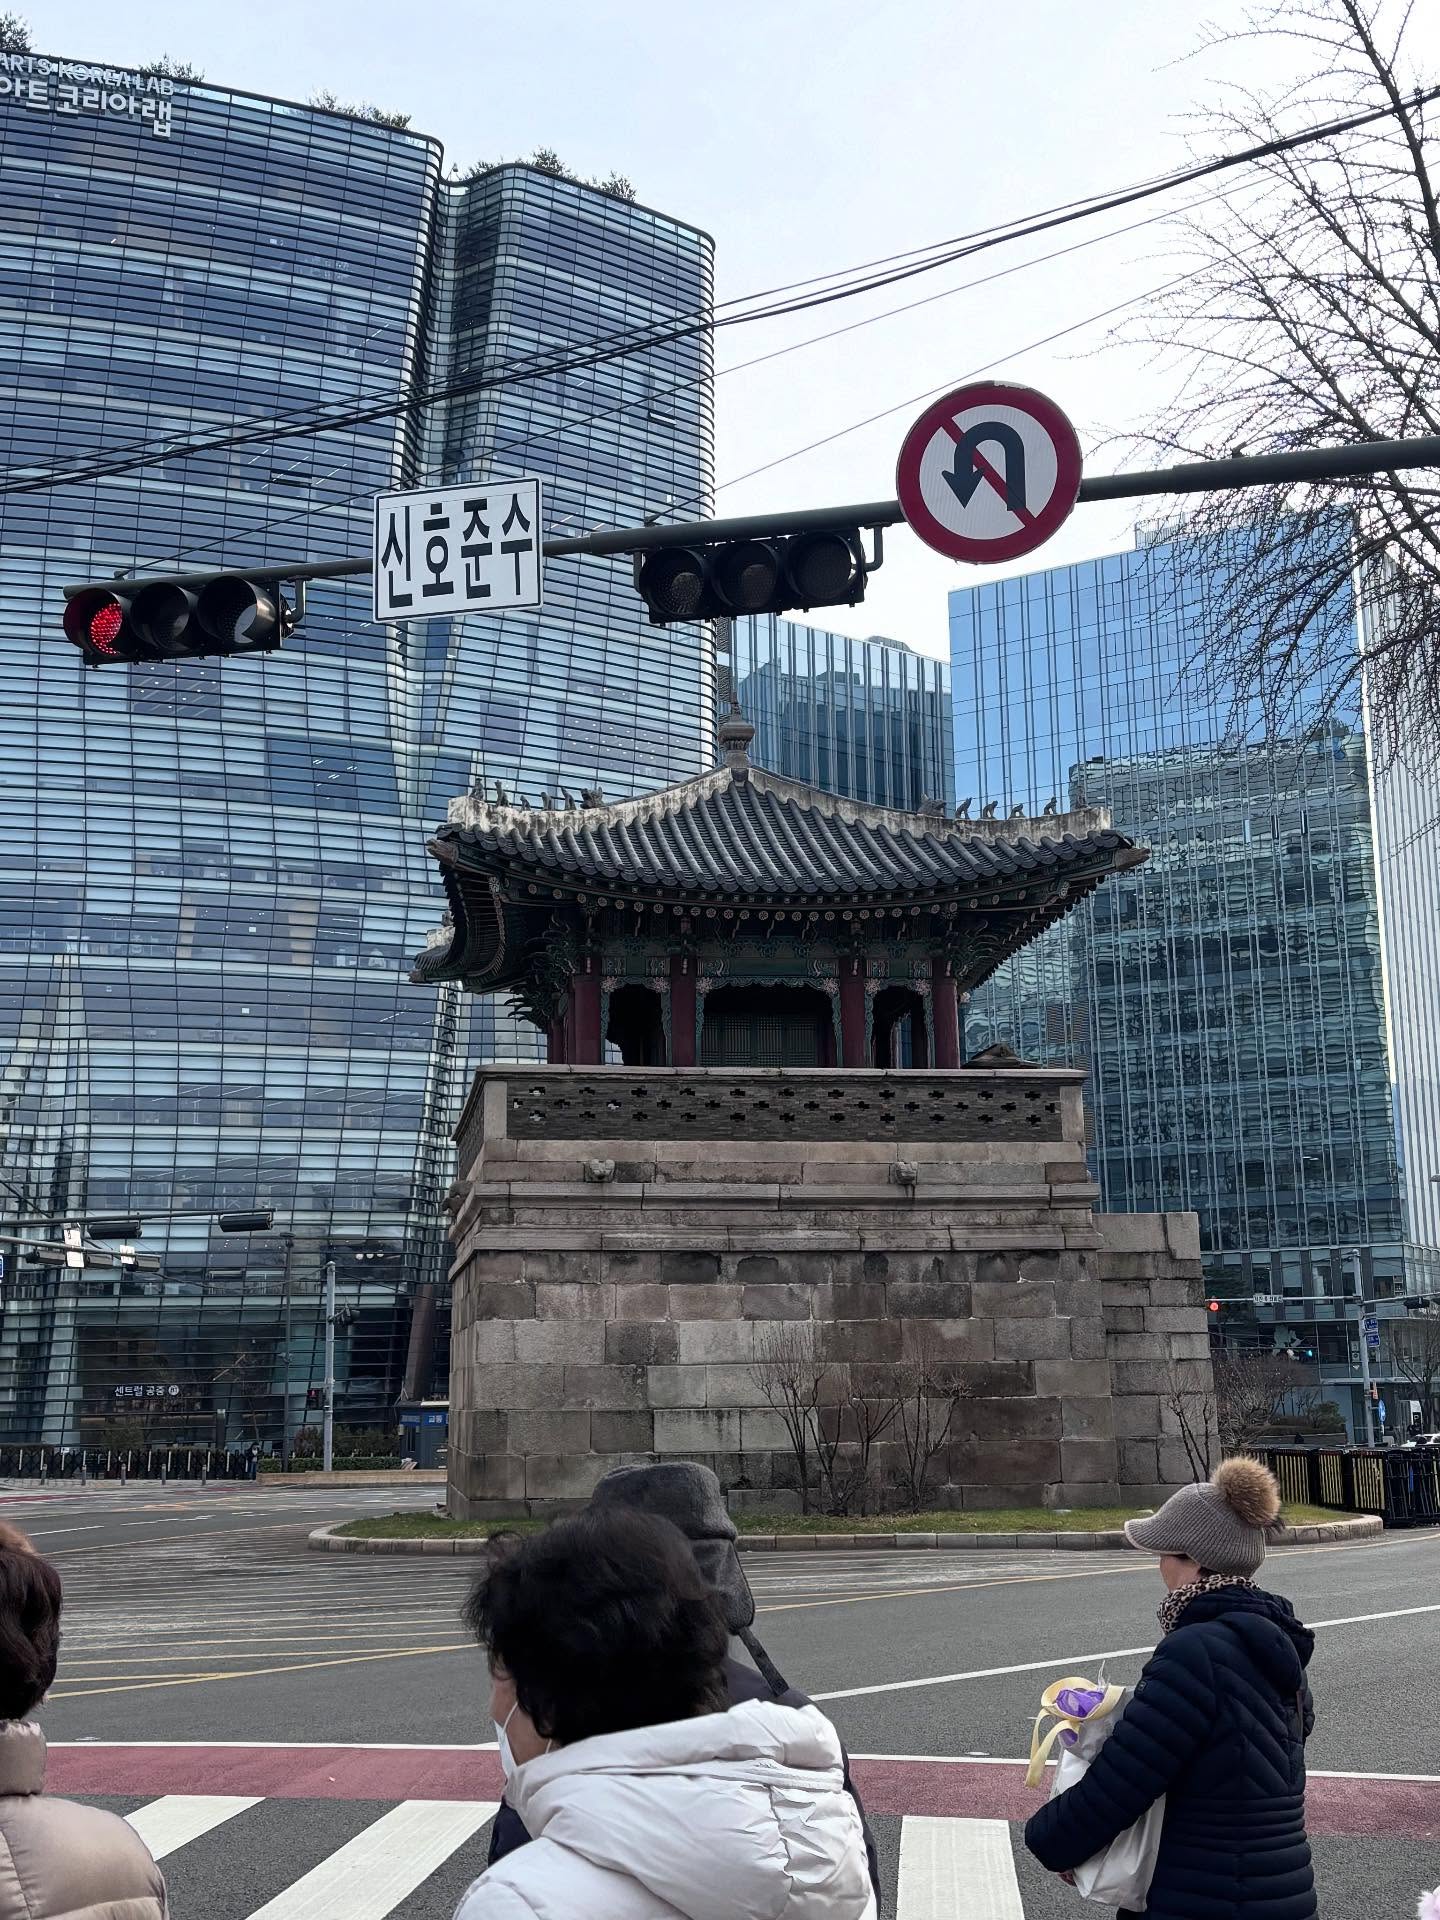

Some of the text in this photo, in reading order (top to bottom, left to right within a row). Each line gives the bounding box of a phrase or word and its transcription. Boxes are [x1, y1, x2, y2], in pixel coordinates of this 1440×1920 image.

[0, 52, 174, 96] ARTS KOREA LAB
[381, 493, 533, 609] 신호준수
[114, 1385, 143, 1397] 센트럴
